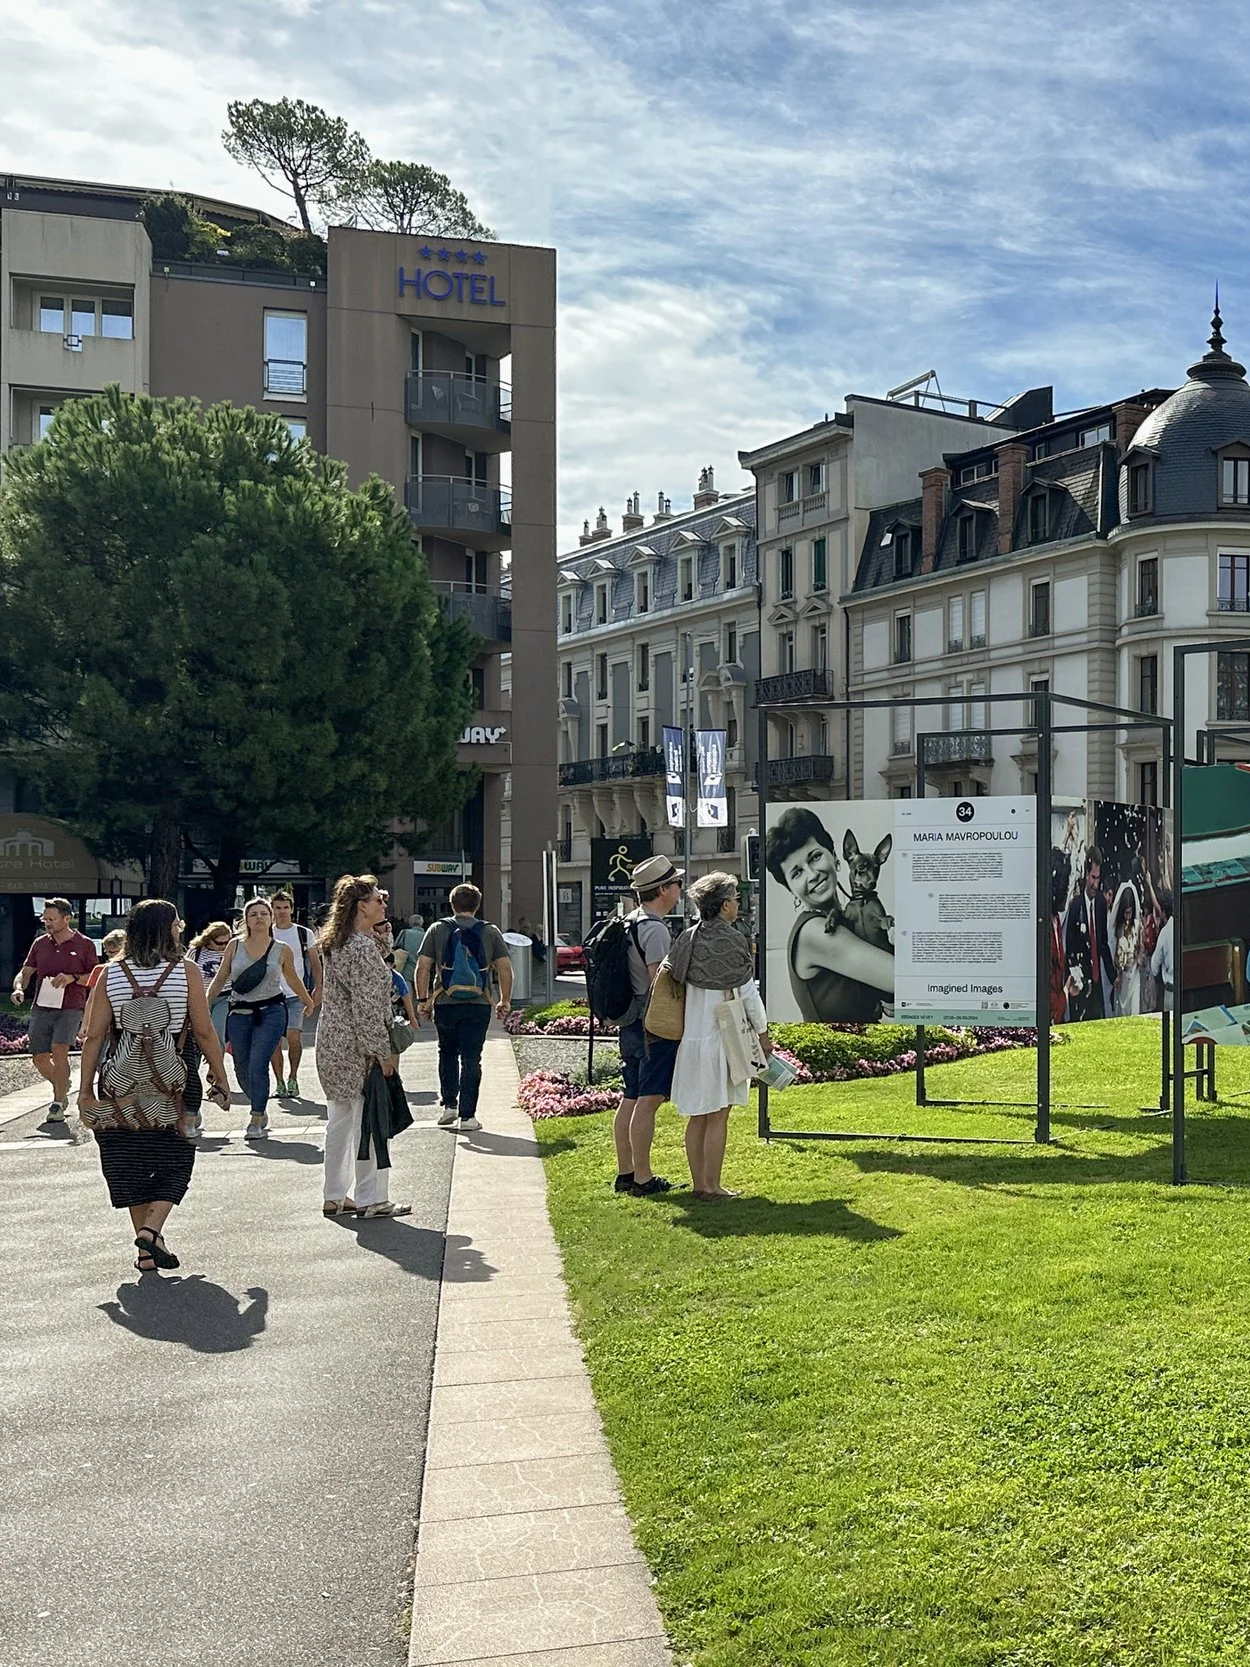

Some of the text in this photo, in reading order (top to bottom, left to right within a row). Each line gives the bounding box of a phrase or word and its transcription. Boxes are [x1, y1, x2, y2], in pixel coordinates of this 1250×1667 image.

[398, 266, 506, 307] HOTEL
[958, 806, 972, 817] 34
[913, 831, 1019, 842] MARIA MAVROPOULOU
[426, 863, 459, 873] SUBWAY
[927, 983, 1004, 996] Imagined Images
